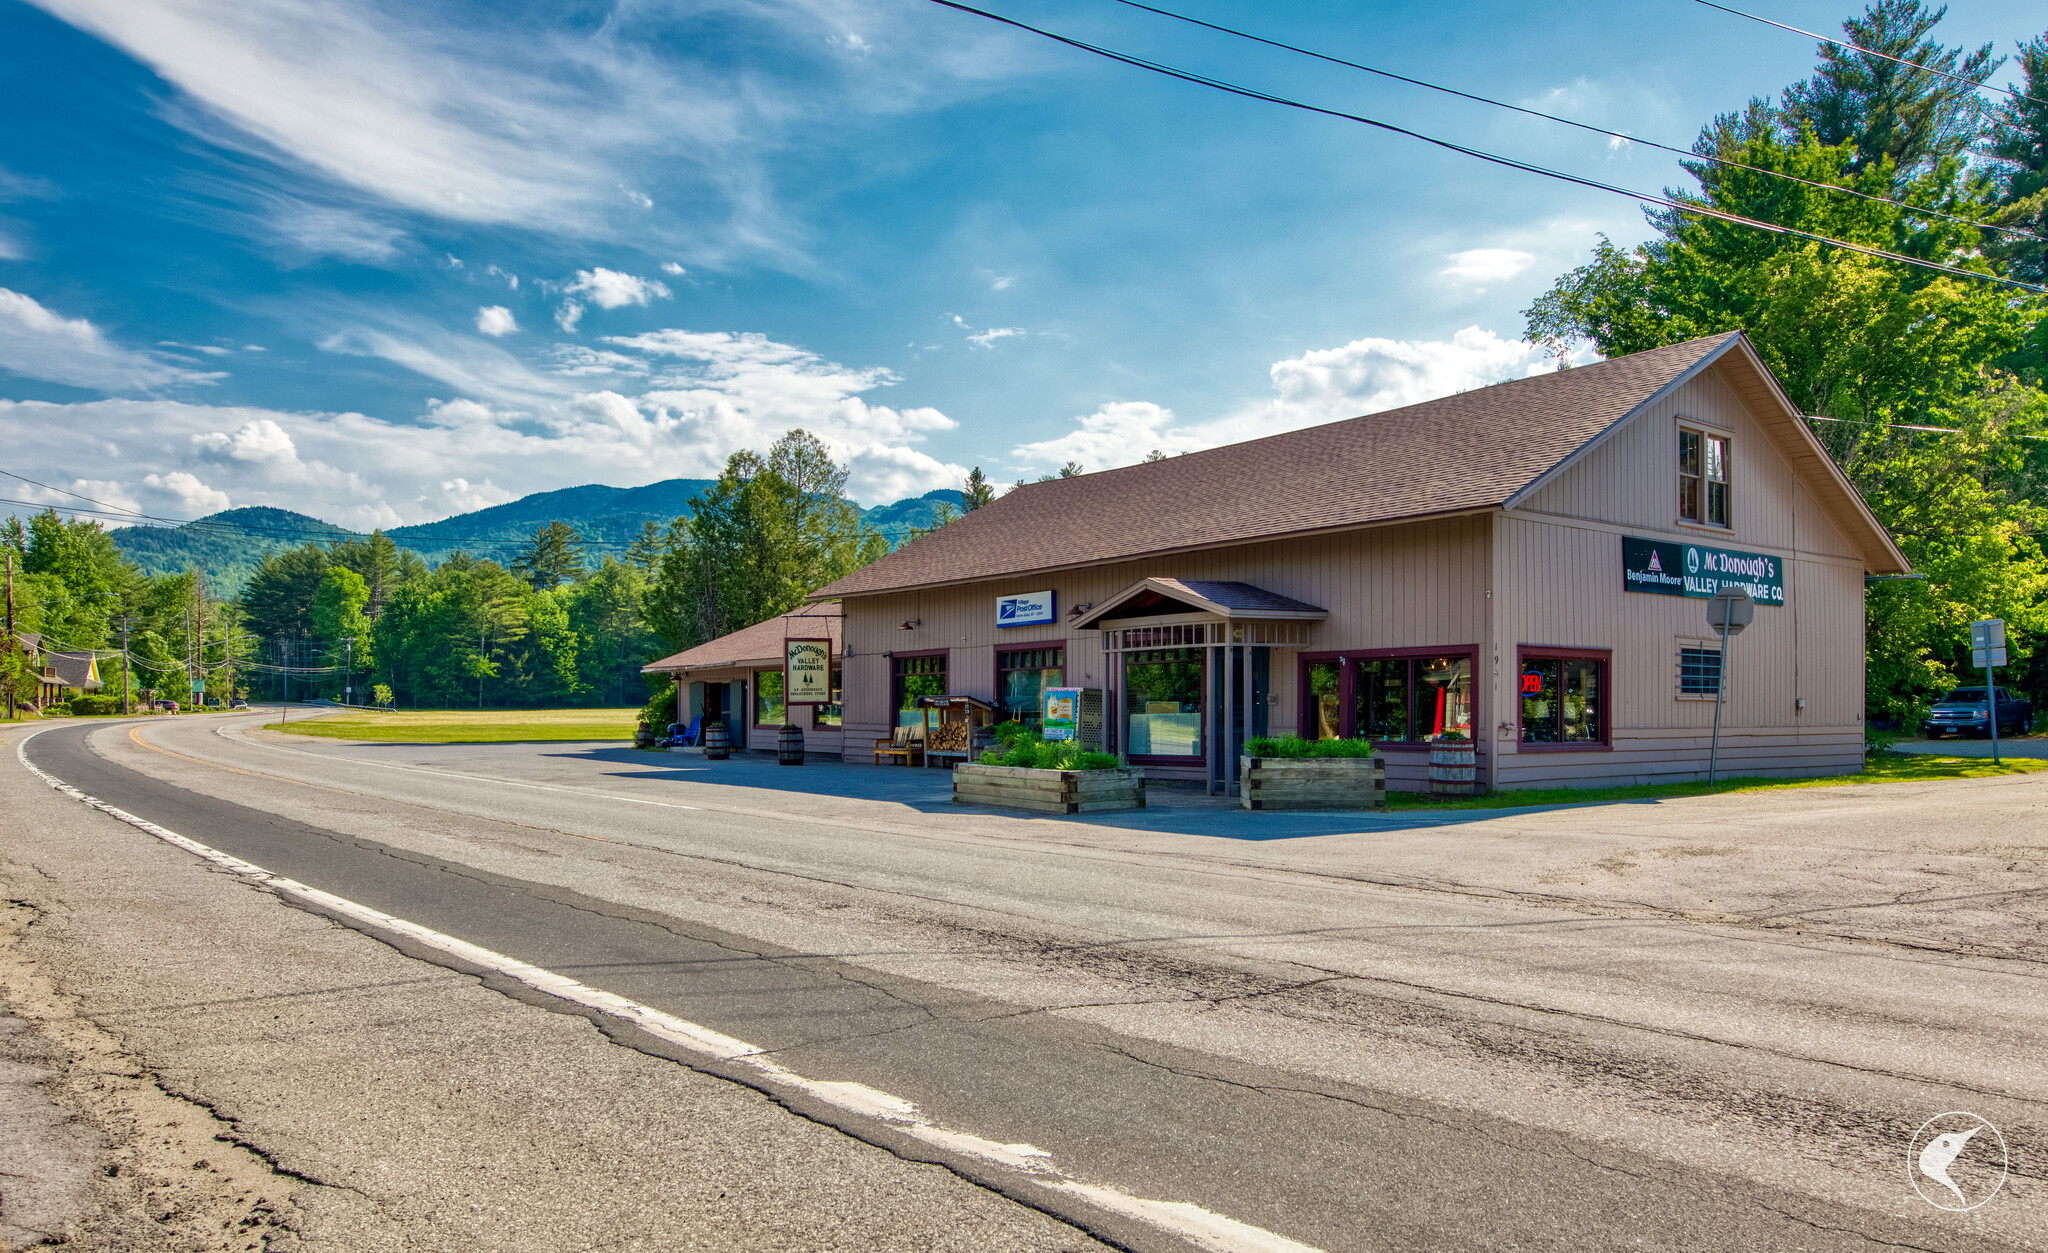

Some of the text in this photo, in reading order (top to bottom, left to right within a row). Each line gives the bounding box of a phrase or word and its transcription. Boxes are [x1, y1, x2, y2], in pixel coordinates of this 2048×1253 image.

[1627, 568, 1659, 584] Benjamin
[1704, 552, 1775, 582] Mc Donough's
[1683, 575, 1718, 594] VALLEY
[1771, 585, 1784, 601] CO.
[788, 645, 828, 660] McDonough's
[1522, 674, 1542, 692] OPEN
